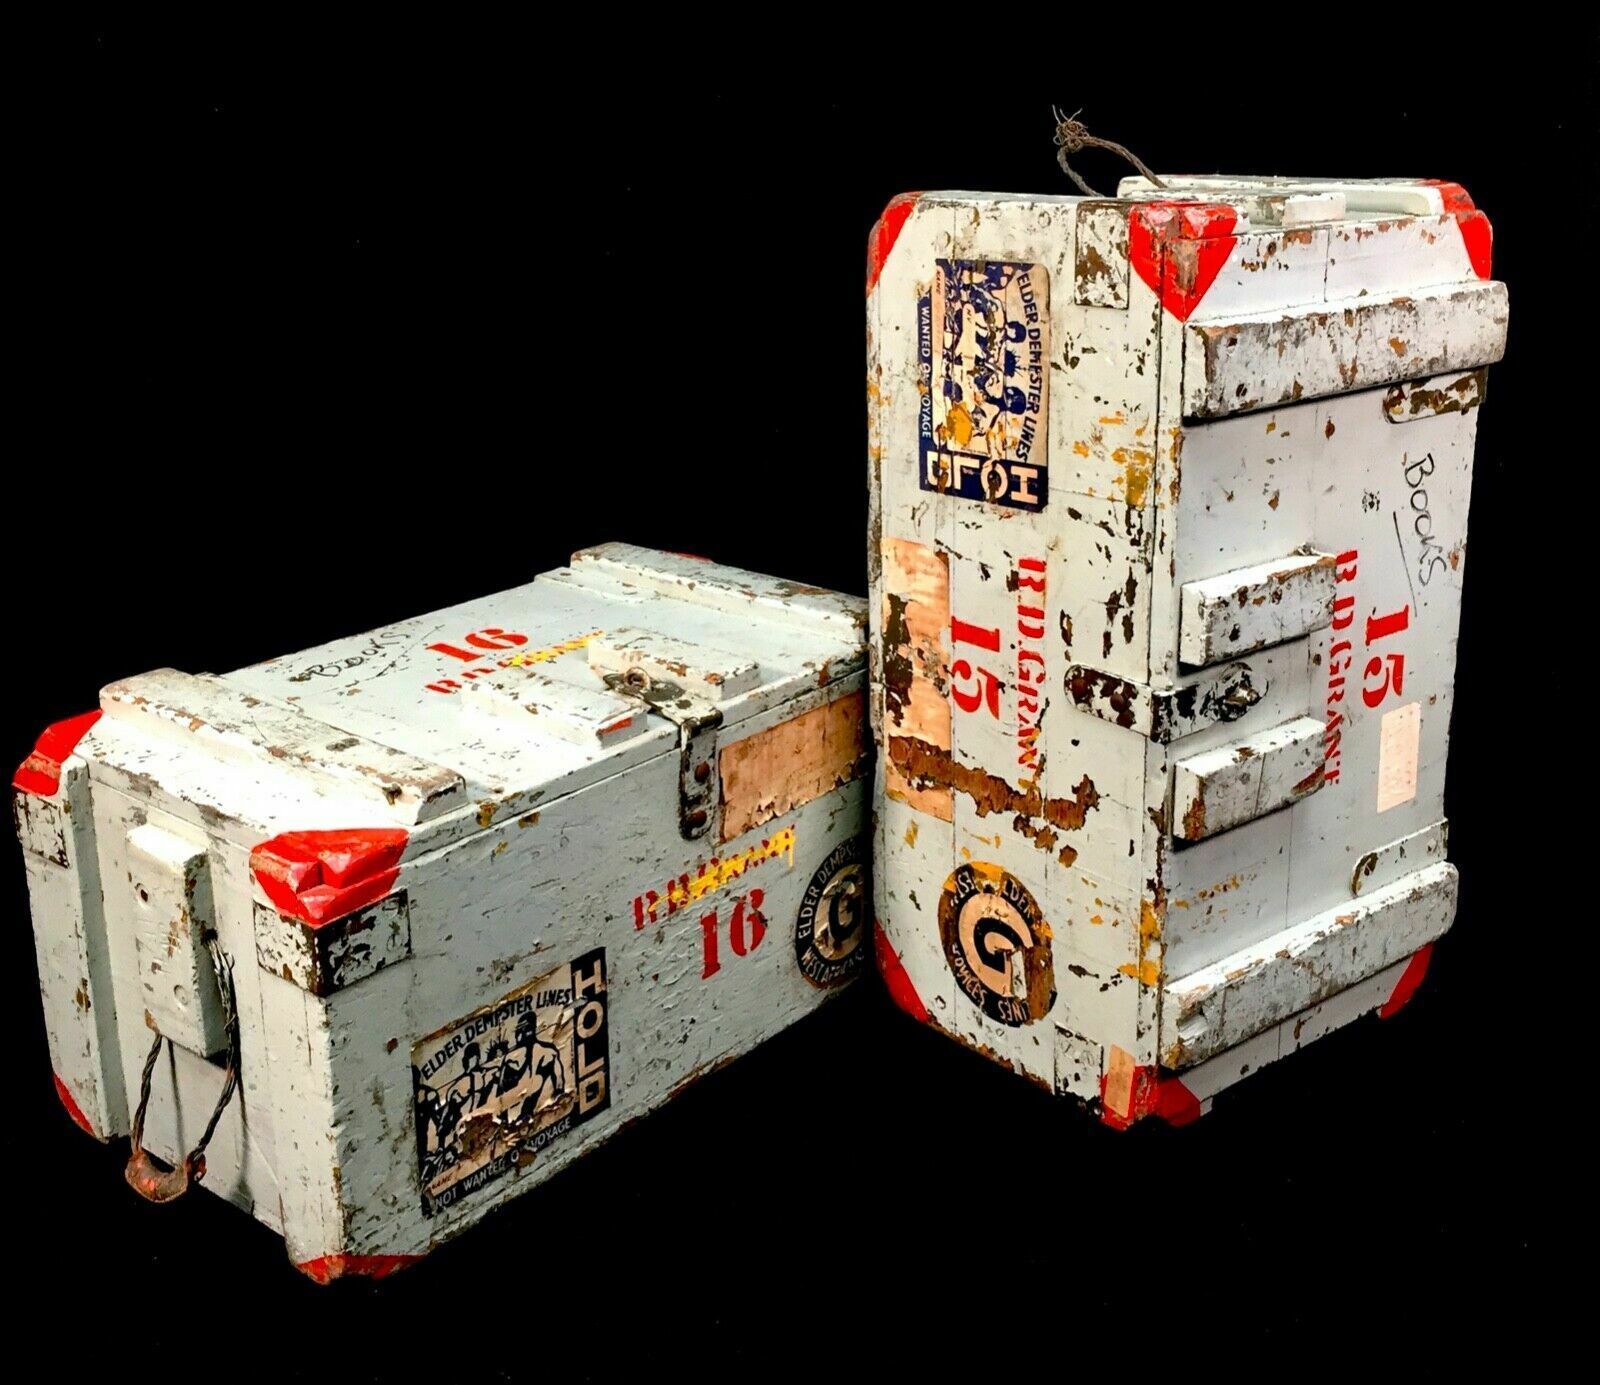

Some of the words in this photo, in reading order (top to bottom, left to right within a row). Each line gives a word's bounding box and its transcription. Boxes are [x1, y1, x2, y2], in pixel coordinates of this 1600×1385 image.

[1016, 273, 1040, 327] ELDER
[920, 305, 932, 358] WANTED
[1025, 328, 1043, 415] DEMPSTER
[1015, 415, 1038, 463] LINES
[926, 451, 1039, 505] HOLD
[425, 627, 529, 663] 16
[951, 614, 1001, 721] 15
[1362, 604, 1410, 709] 15
[700, 888, 768, 980] 16
[798, 884, 820, 939] ELDER
[421, 1036, 467, 1081] ELDER
[465, 994, 535, 1041] DEMPSTER
[535, 987, 572, 1010] LINES
[574, 959, 606, 1116] HOLD
[434, 1187, 458, 1209] NOT
